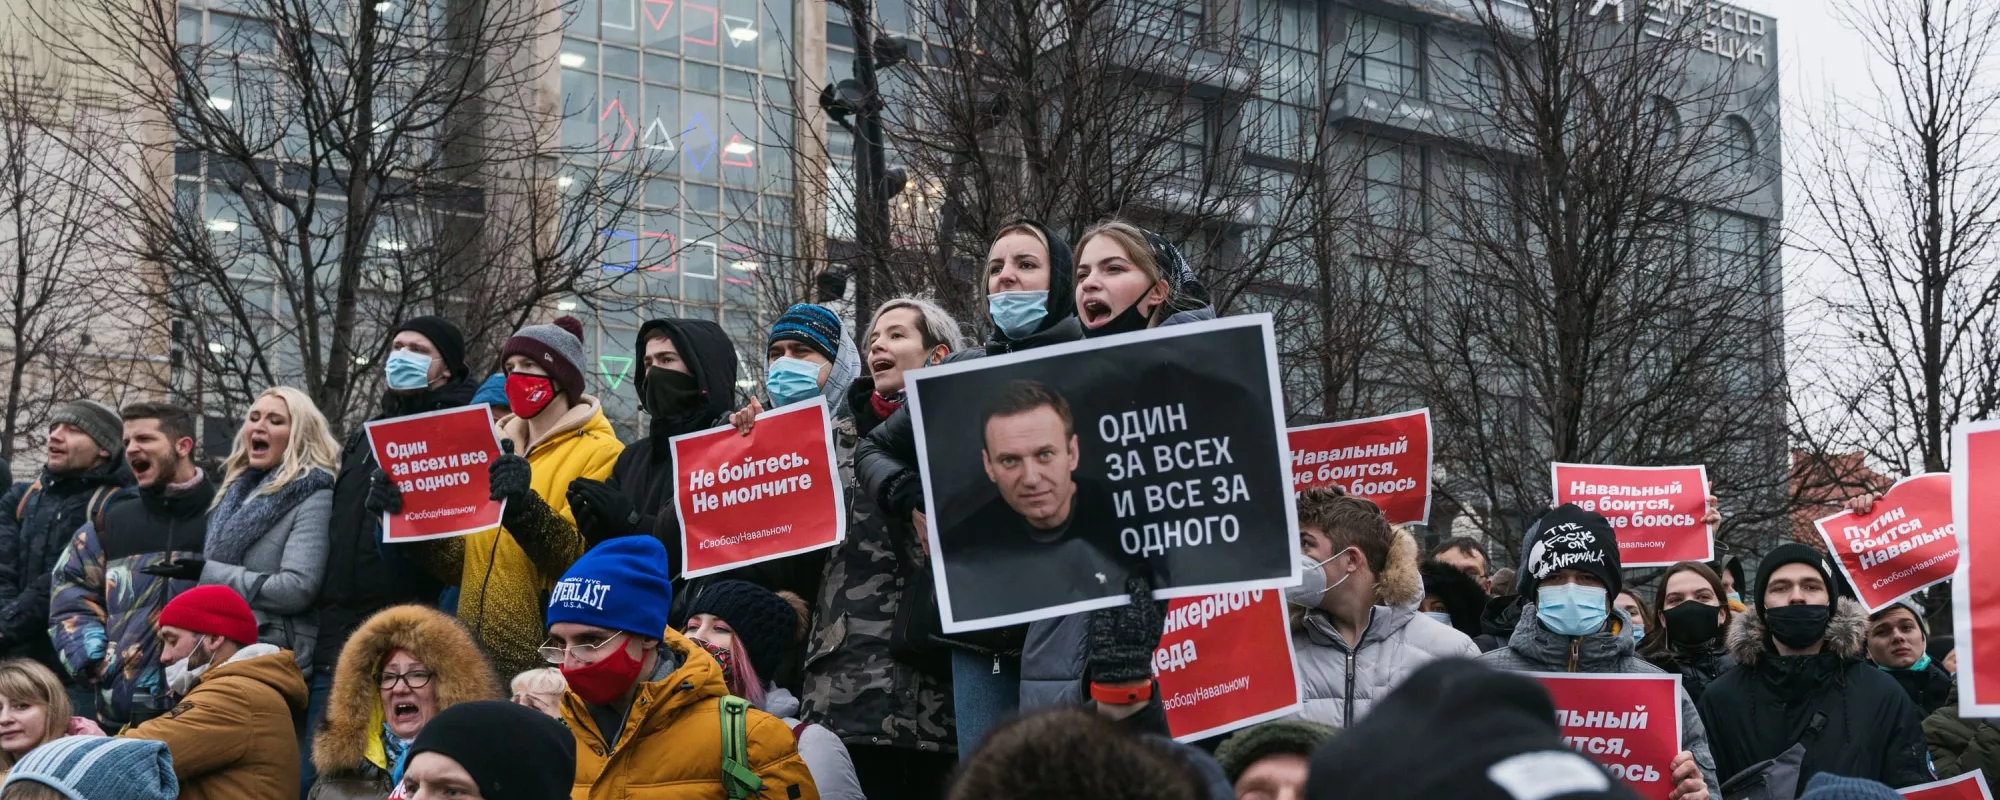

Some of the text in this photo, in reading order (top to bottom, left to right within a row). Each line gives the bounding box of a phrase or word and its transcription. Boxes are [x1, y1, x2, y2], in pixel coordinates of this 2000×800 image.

[1099, 403, 1187, 447] ОДИН
[386, 440, 428, 460] Один
[391, 450, 488, 476] за всех и все
[1105, 436, 1234, 481] ЗА ВСЕХ
[1290, 436, 1408, 466] Навальный
[397, 471, 470, 493] за одного
[689, 452, 810, 491] Не бойтесь.
[1317, 461, 1398, 482] боится,
[691, 473, 812, 514] Не молчите
[1112, 474, 1250, 518] И ВСЕ ЗА
[1350, 477, 1417, 497] боюсь
[1570, 480, 1683, 497] Навальный
[405, 505, 477, 521] #СвободуНавальному
[1599, 495, 1675, 512] боится,
[1631, 510, 1695, 528] боюсь
[1843, 506, 1906, 540] Путин
[699, 524, 793, 550] #СвободуНавальному
[1120, 514, 1240, 558] ОДНОГО
[1850, 518, 1923, 554] боится
[1858, 523, 1956, 571] Навально
[1871, 548, 1960, 590] #СвободуНавальном
[1555, 704, 1648, 729] льный
